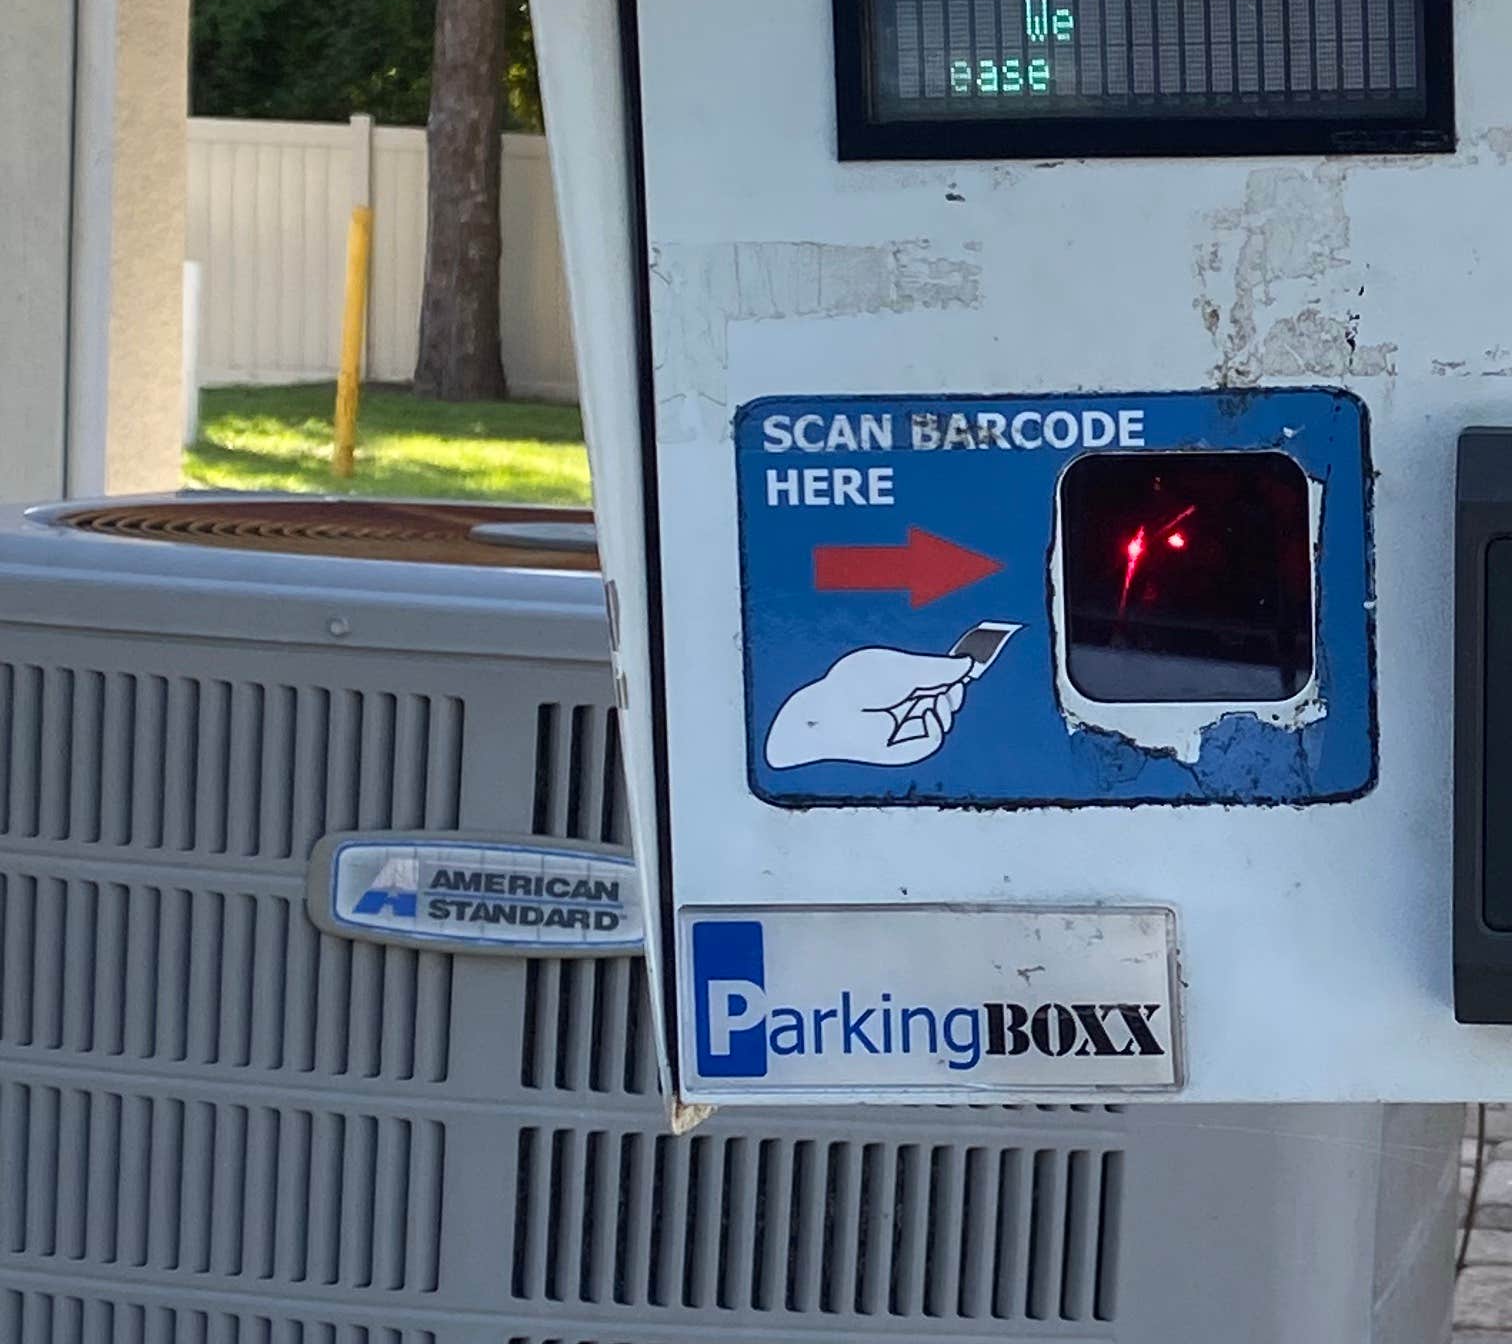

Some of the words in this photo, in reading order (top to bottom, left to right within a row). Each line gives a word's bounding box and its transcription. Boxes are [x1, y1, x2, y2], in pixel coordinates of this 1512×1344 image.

[951, 59, 1050, 91] ease
[764, 414, 892, 452] SCAN
[912, 410, 1144, 449] BARCODE
[767, 468, 894, 505] HERE
[430, 869, 620, 902] AMERICAN
[428, 898, 620, 931] STANDARD
